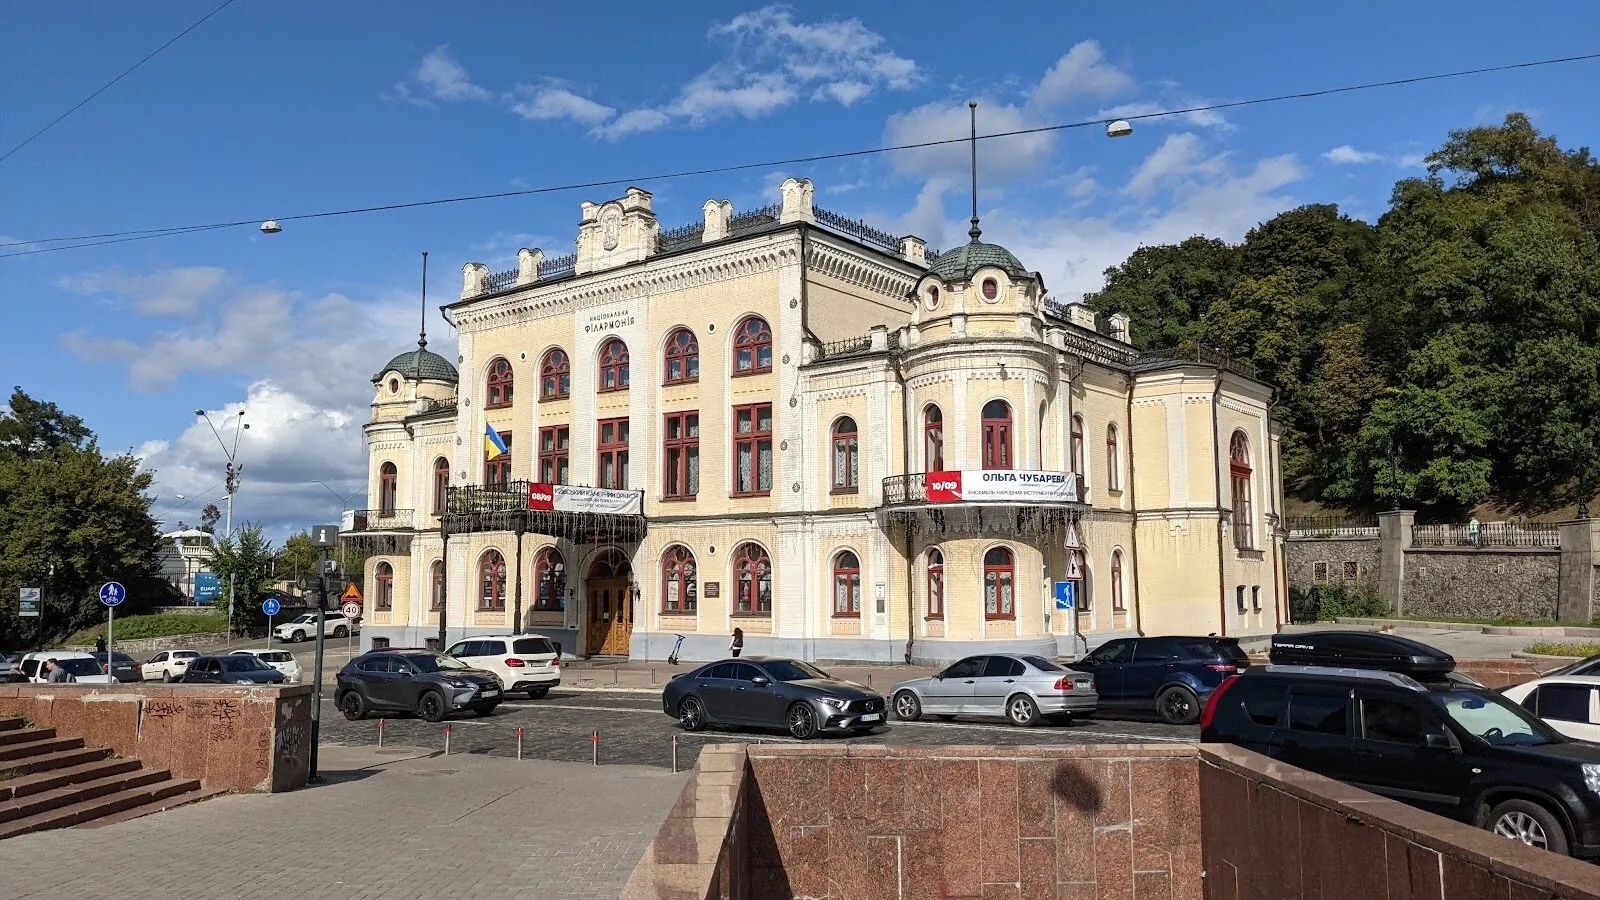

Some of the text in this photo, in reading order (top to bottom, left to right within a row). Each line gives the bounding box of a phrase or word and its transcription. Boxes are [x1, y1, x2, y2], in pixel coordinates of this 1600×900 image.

[590, 310, 629, 321] НАЦІОНАЛЬНА
[584, 316, 635, 333] ФІЛАРМОНІЯ
[982, 473, 1066, 483] ОЛЬГА ЧУБАРЕВА
[931, 481, 958, 491] 10/09
[531, 493, 552, 502] 08/09
[345, 606, 357, 614] 40
